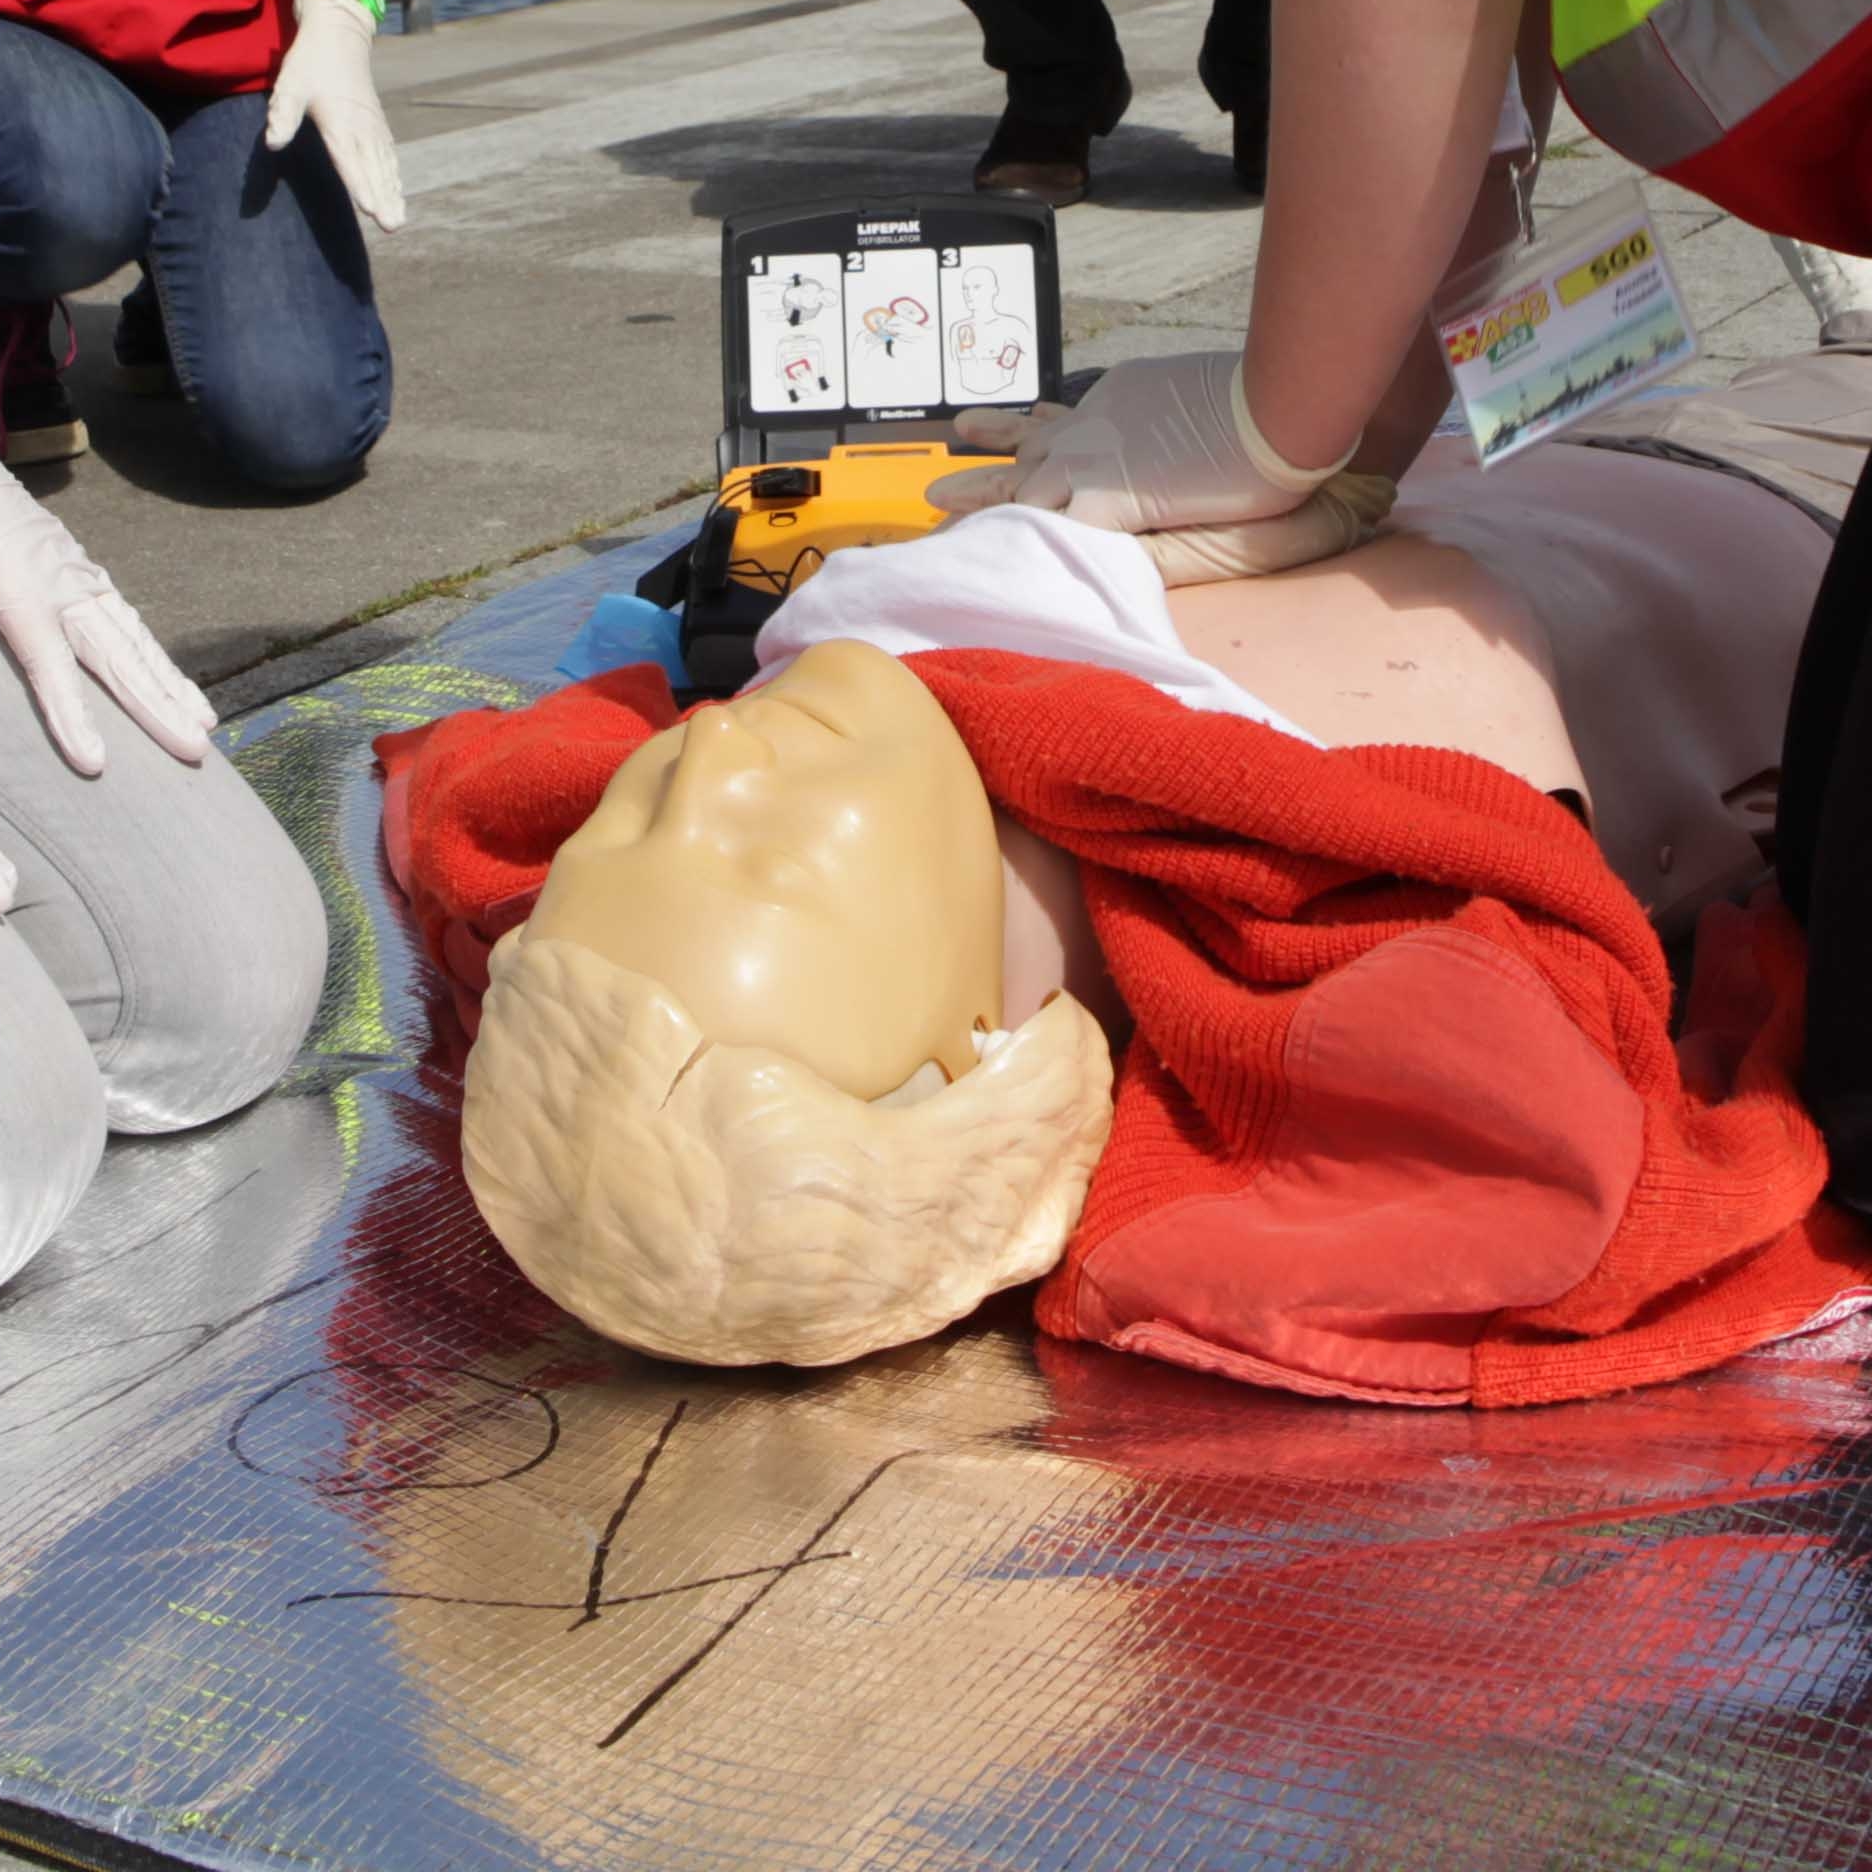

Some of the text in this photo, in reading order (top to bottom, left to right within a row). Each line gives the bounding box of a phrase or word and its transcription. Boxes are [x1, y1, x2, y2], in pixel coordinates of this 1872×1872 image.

[856, 220, 921, 236] LIFEPAK
[750, 255, 764, 275] 1
[846, 252, 863, 271] 2
[942, 248, 959, 267] 3
